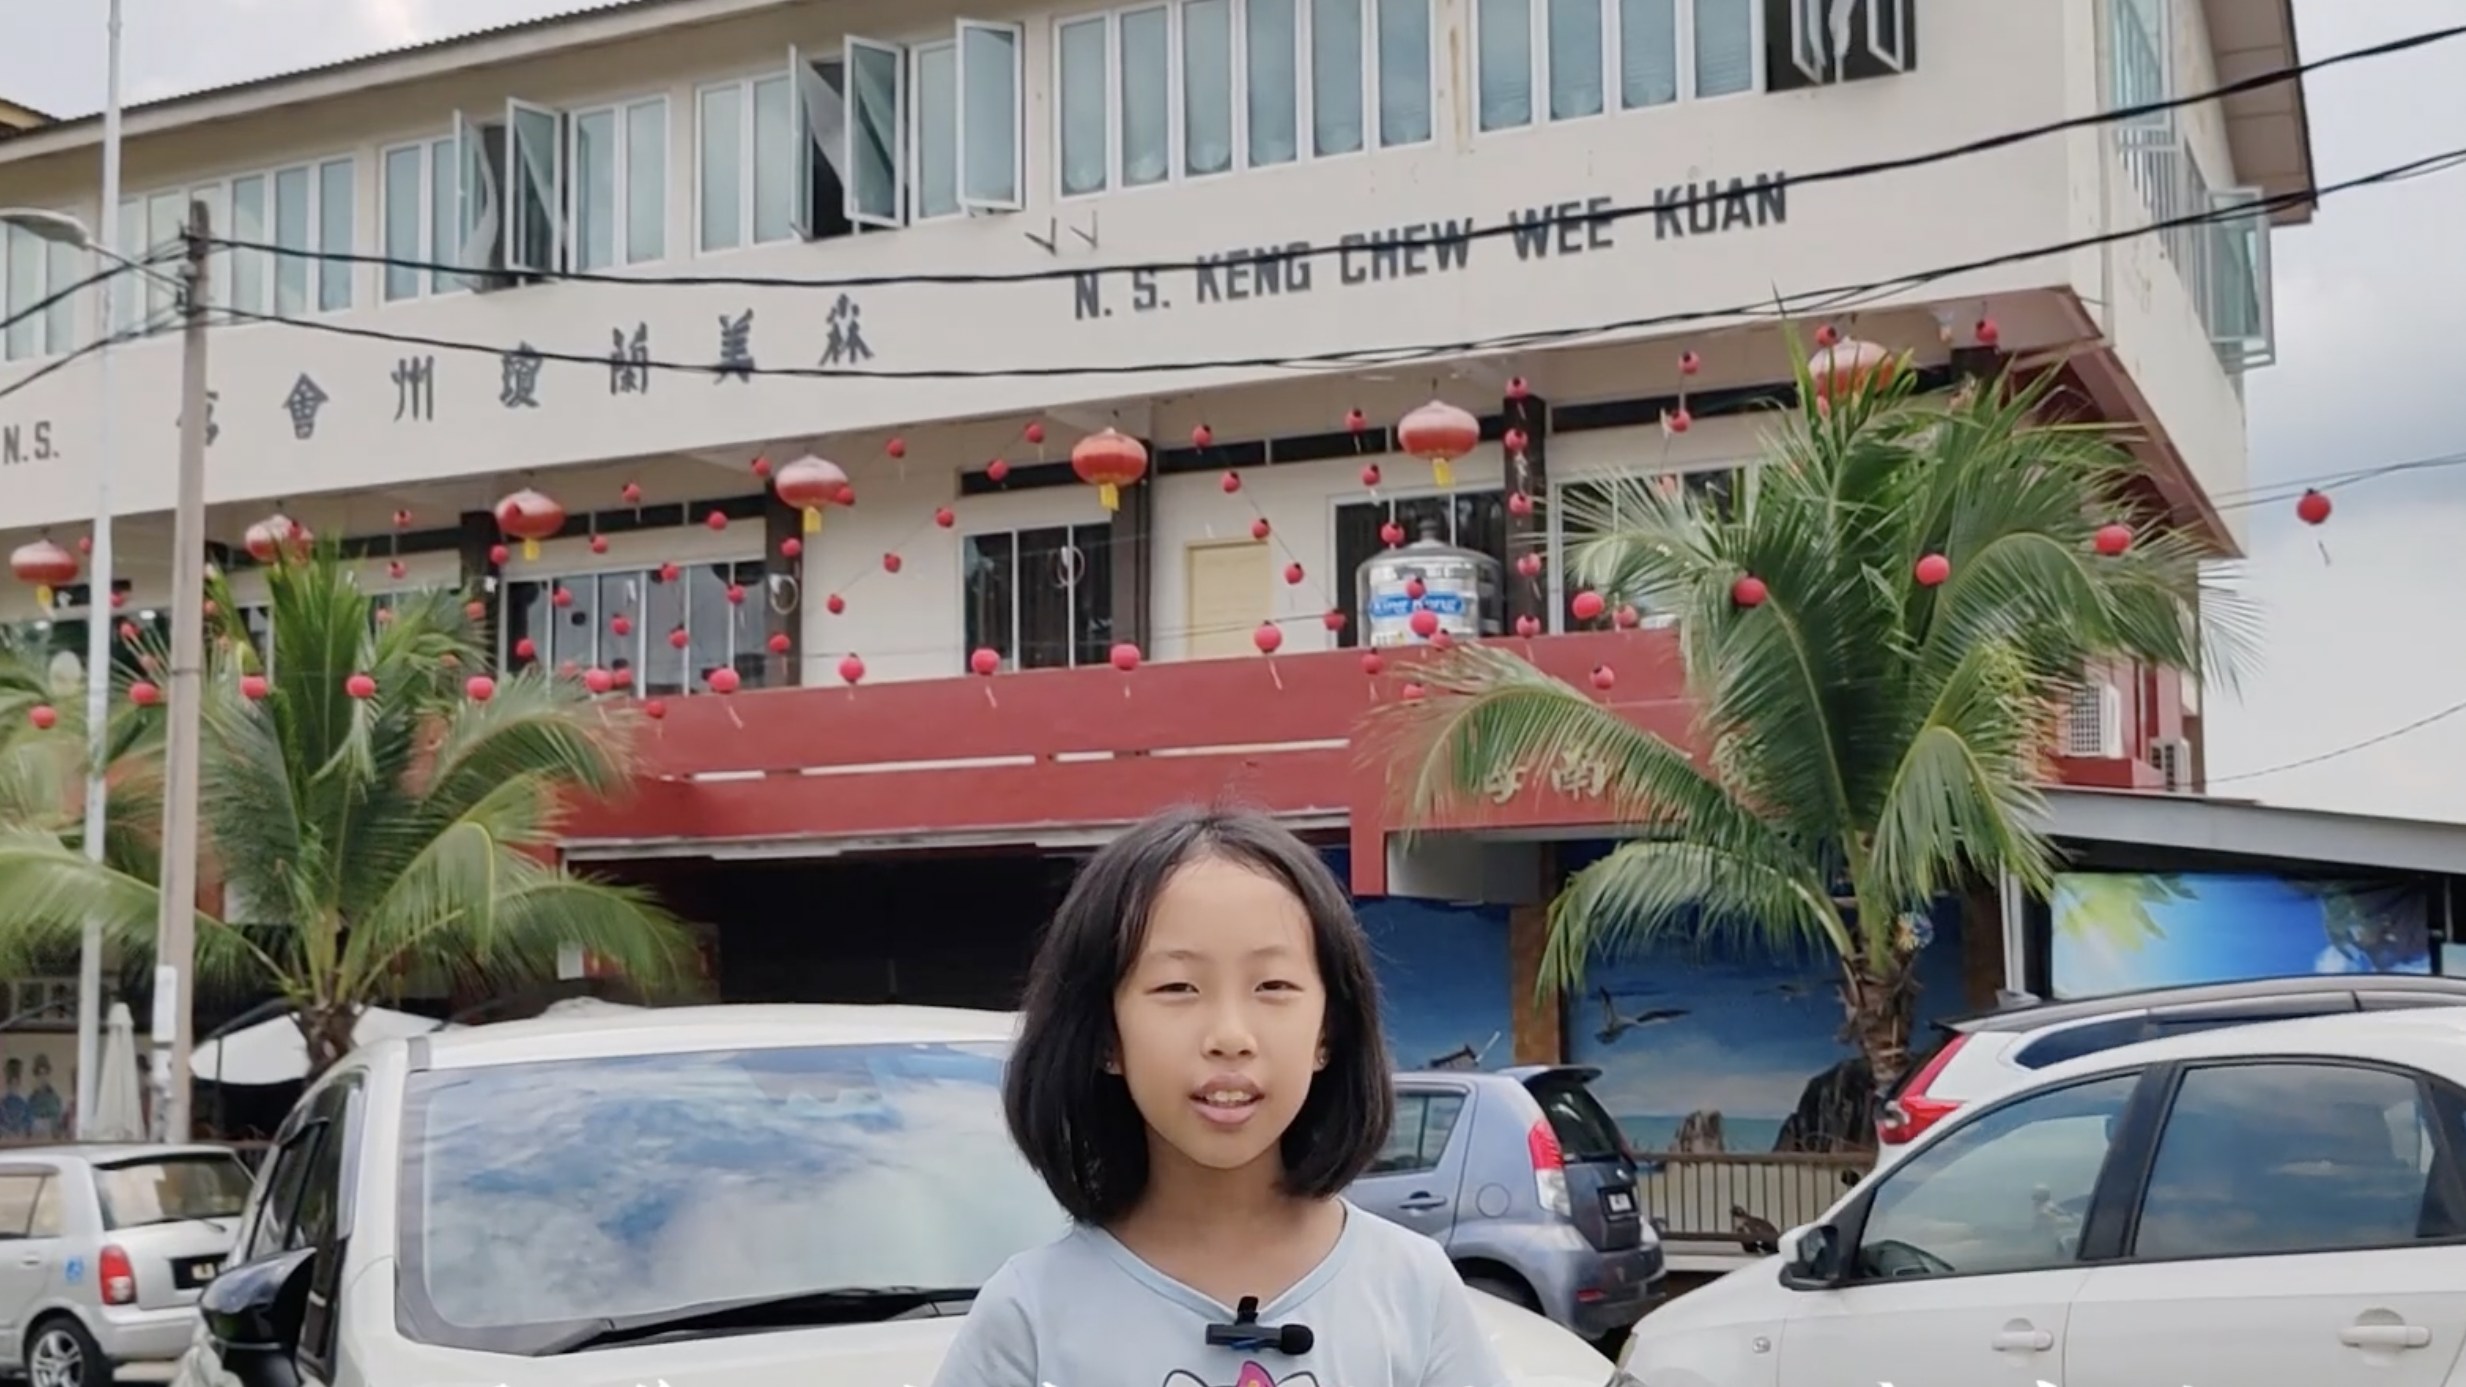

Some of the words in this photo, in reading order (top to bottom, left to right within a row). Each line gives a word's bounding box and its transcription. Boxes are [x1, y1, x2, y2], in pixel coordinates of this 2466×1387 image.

[1196, 240, 1311, 303] KENG
[1339, 217, 1474, 285] CHEW
[1508, 196, 1614, 261] WEE
[1653, 171, 1786, 240] KUAN
